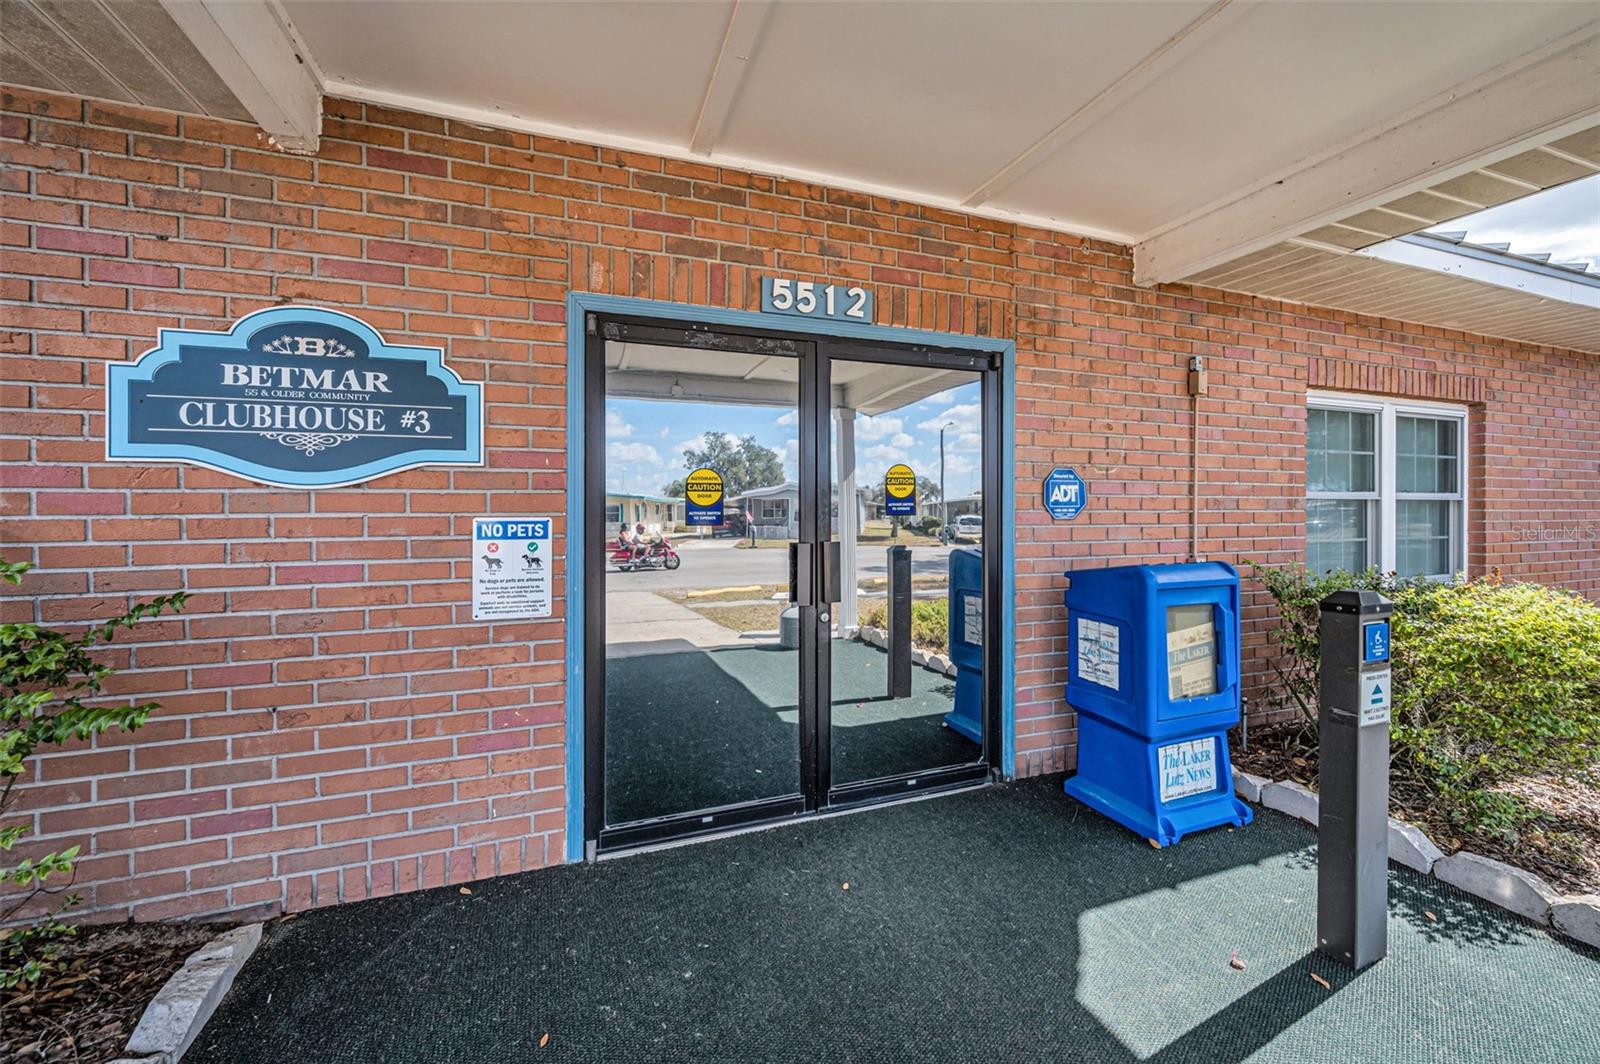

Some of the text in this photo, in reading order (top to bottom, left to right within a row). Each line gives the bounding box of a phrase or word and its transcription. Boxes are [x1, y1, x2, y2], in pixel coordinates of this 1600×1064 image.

[772, 278, 866, 318] 5512
[292, 336, 328, 356] B
[220, 363, 392, 393] BETMAR
[261, 389, 269, 397] &
[271, 390, 304, 398] OLDER
[309, 392, 371, 401] COMMUNITY
[179, 402, 431, 433] CLUBHOUSE #3
[1050, 485, 1078, 502] ADT
[482, 524, 544, 537] NO PETS
[1174, 646, 1210, 663] The LAKER
[1163, 750, 1211, 770] The LAKER
[1166, 768, 1211, 789] Lutz NEWS
